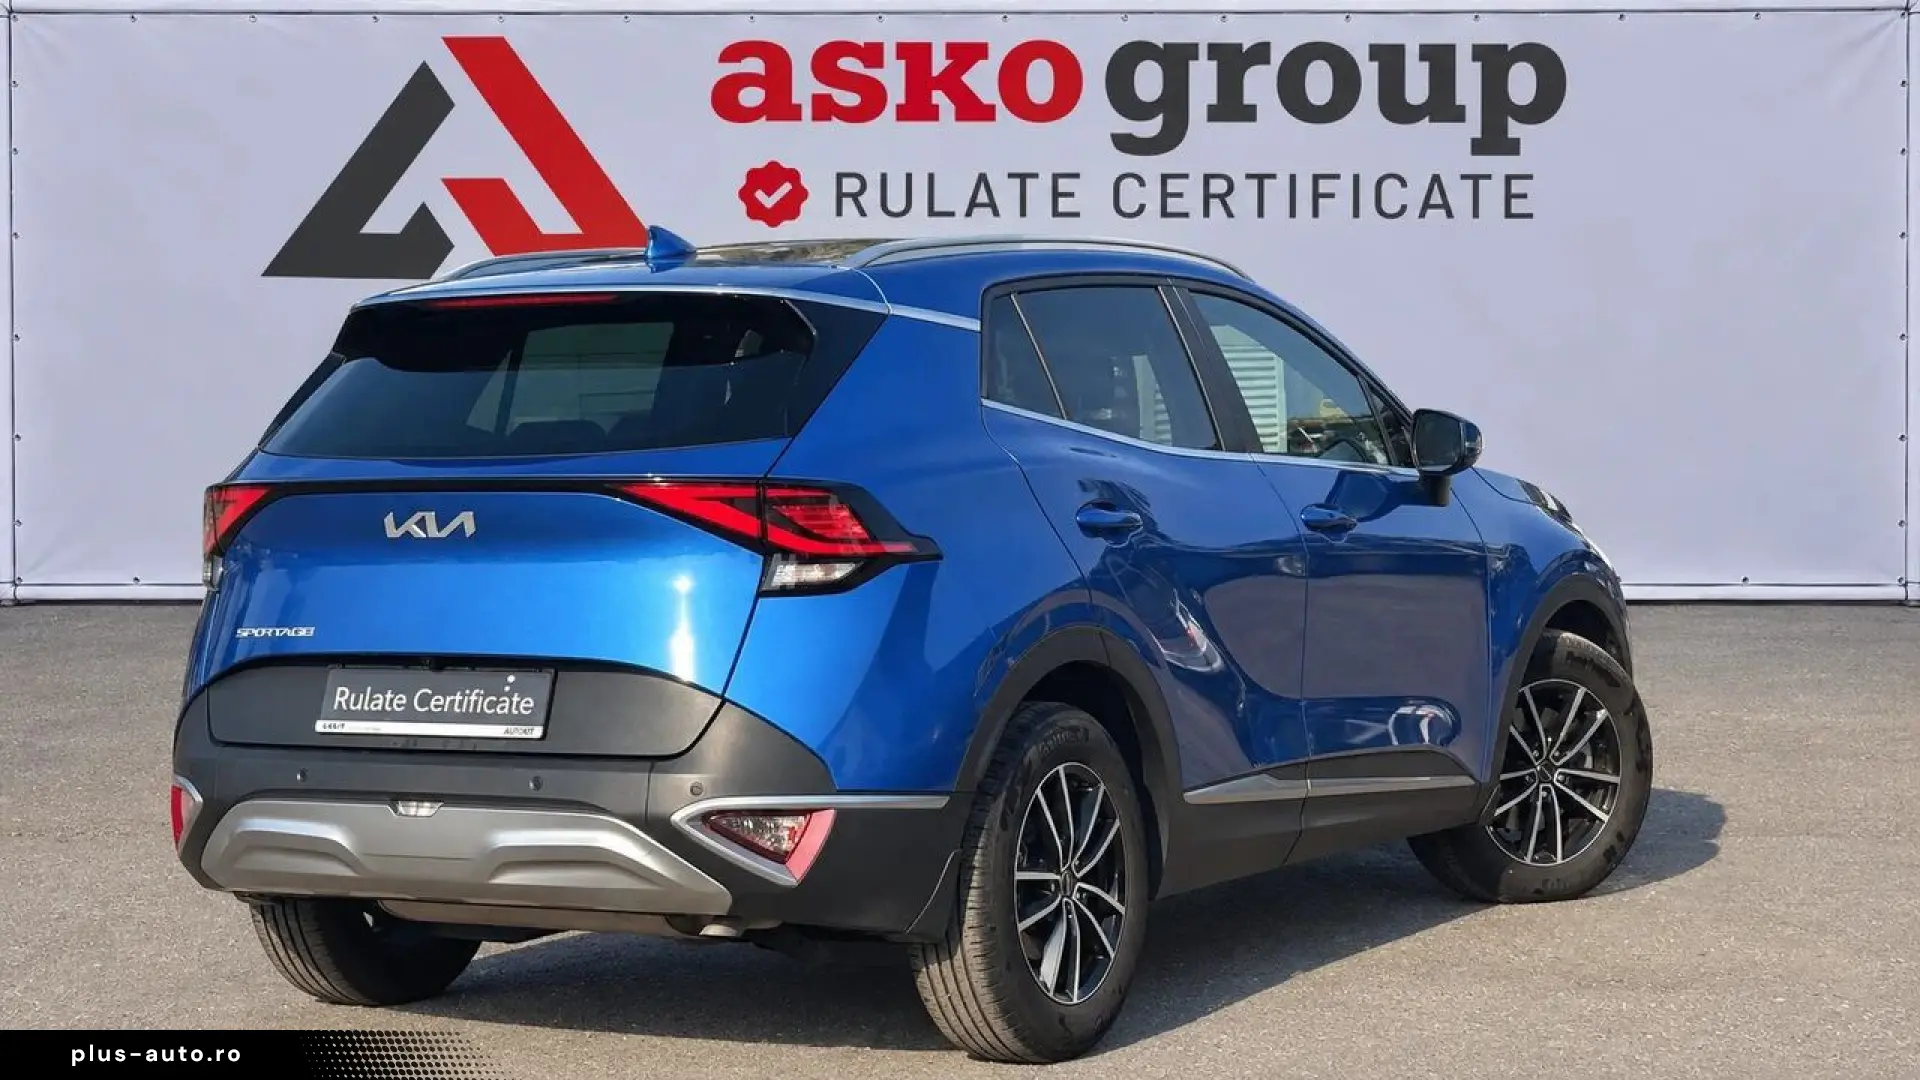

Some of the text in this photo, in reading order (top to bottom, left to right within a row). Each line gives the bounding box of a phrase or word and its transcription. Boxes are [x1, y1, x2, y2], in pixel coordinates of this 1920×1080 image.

[711, 40, 1566, 156] asko group
[836, 173, 1533, 219] RULATE CERTIFICATE
[384, 511, 476, 538] KIA
[236, 626, 316, 638] SPORTAGE
[333, 686, 535, 715] Rulate Certificate
